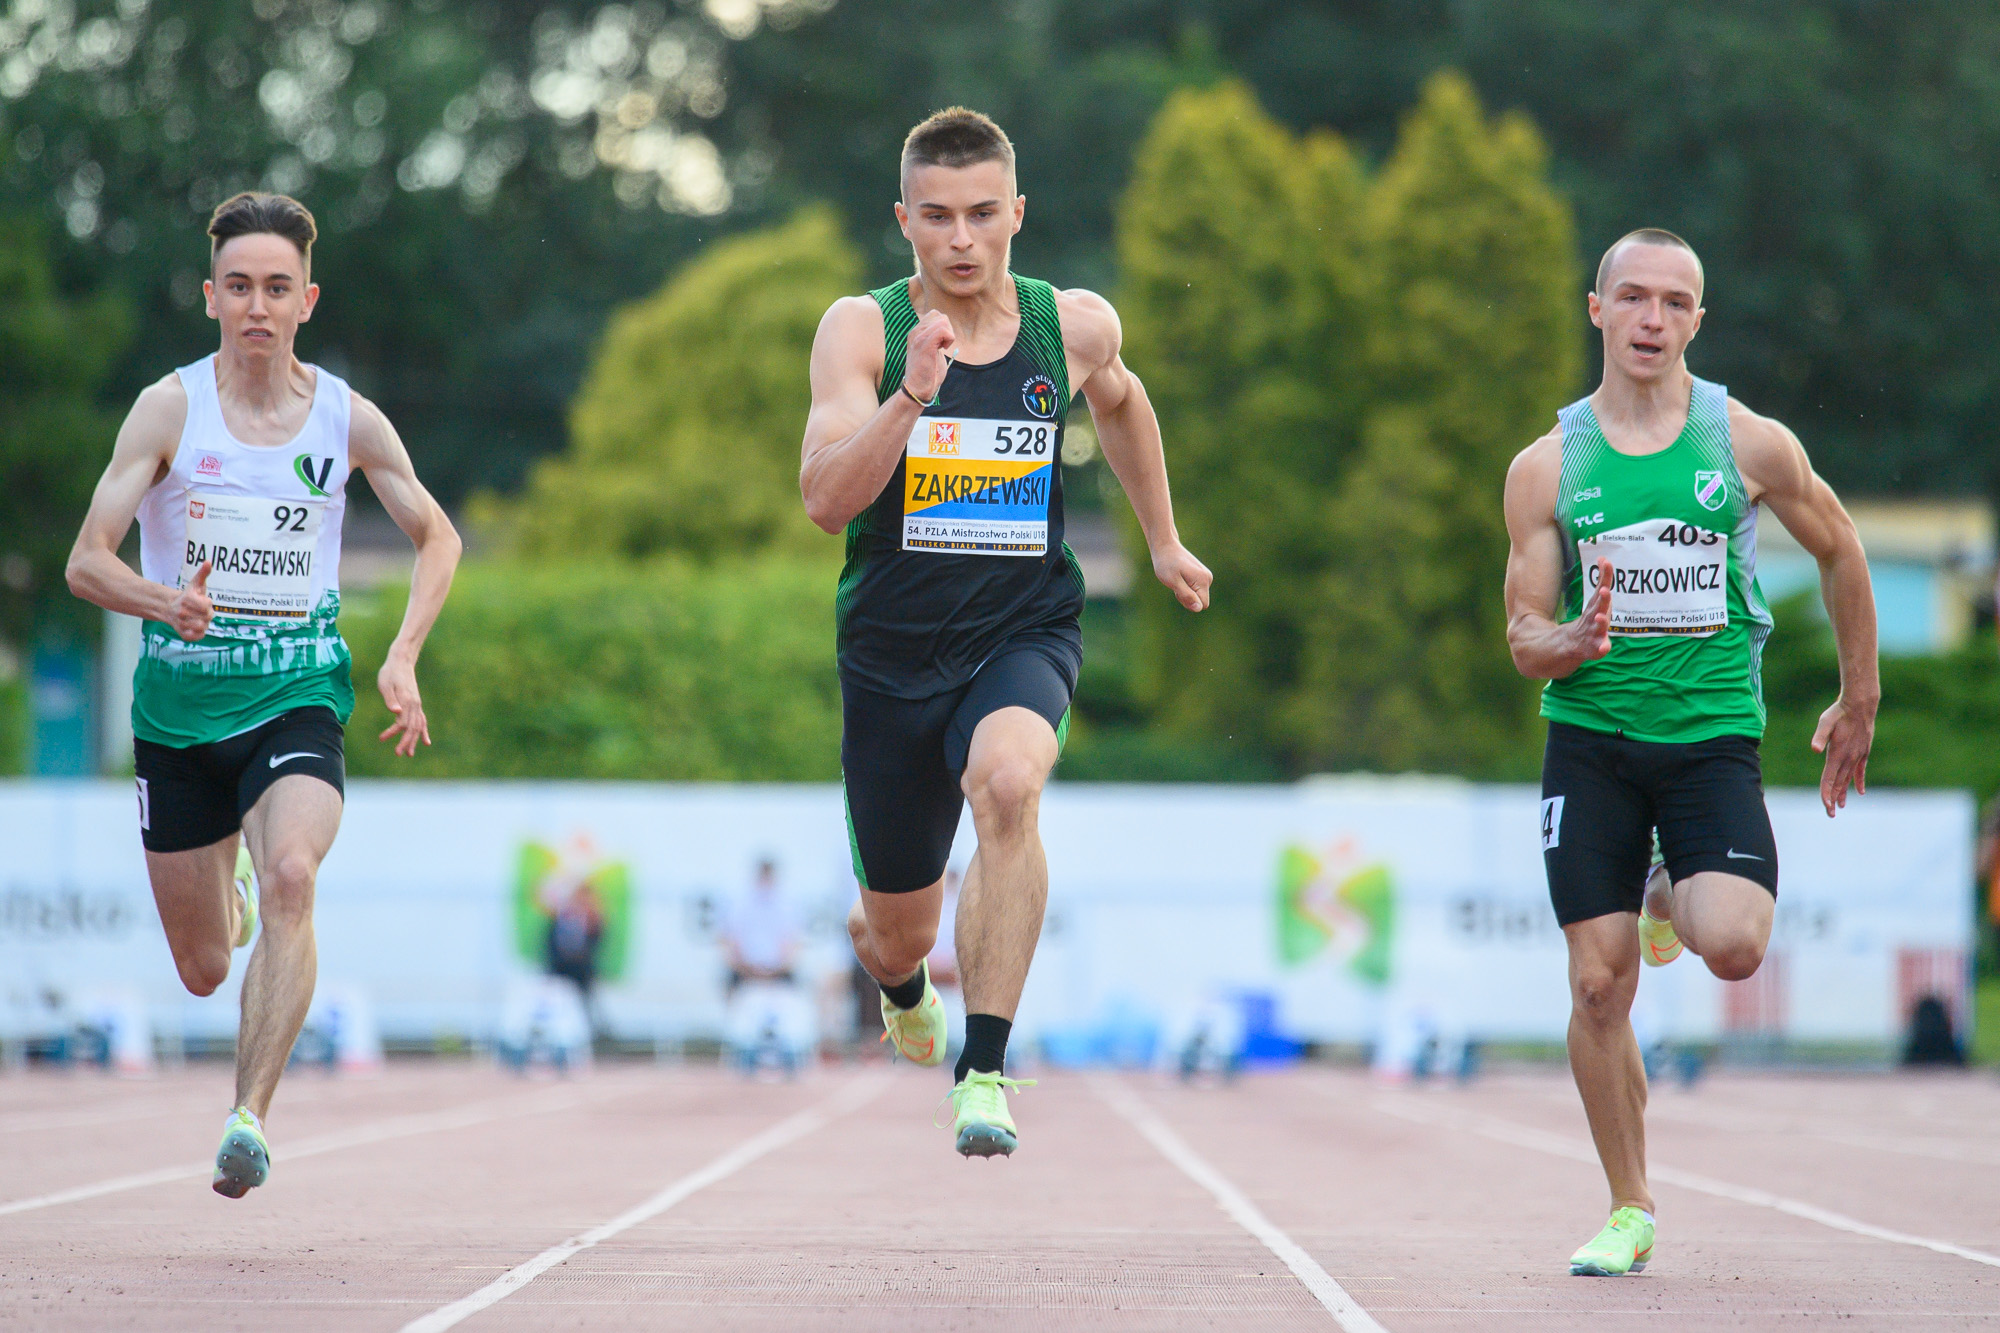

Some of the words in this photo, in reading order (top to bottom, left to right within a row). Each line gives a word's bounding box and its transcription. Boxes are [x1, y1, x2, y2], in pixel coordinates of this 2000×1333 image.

[930, 443, 958, 454] PZLA
[993, 426, 1048, 456] 528
[911, 473, 1047, 506] ZAKRZEWSKI
[273, 505, 309, 532] 92
[1574, 512, 1605, 528] TLC
[907, 526, 922, 535] 54.
[925, 526, 949, 537] PZLA
[951, 528, 1008, 540] Mistrzostwa
[1010, 530, 1032, 539] Polski
[1033, 530, 1046, 540] U18
[1657, 524, 1719, 547] 403
[216, 593, 268, 606] Mistrzostwa
[270, 597, 294, 607] Polski
[1624, 615, 1678, 624] Mistrzostwa
[1680, 614, 1707, 623] Polski
[1709, 611, 1725, 621] U18
[1542, 801, 1554, 845] 4
